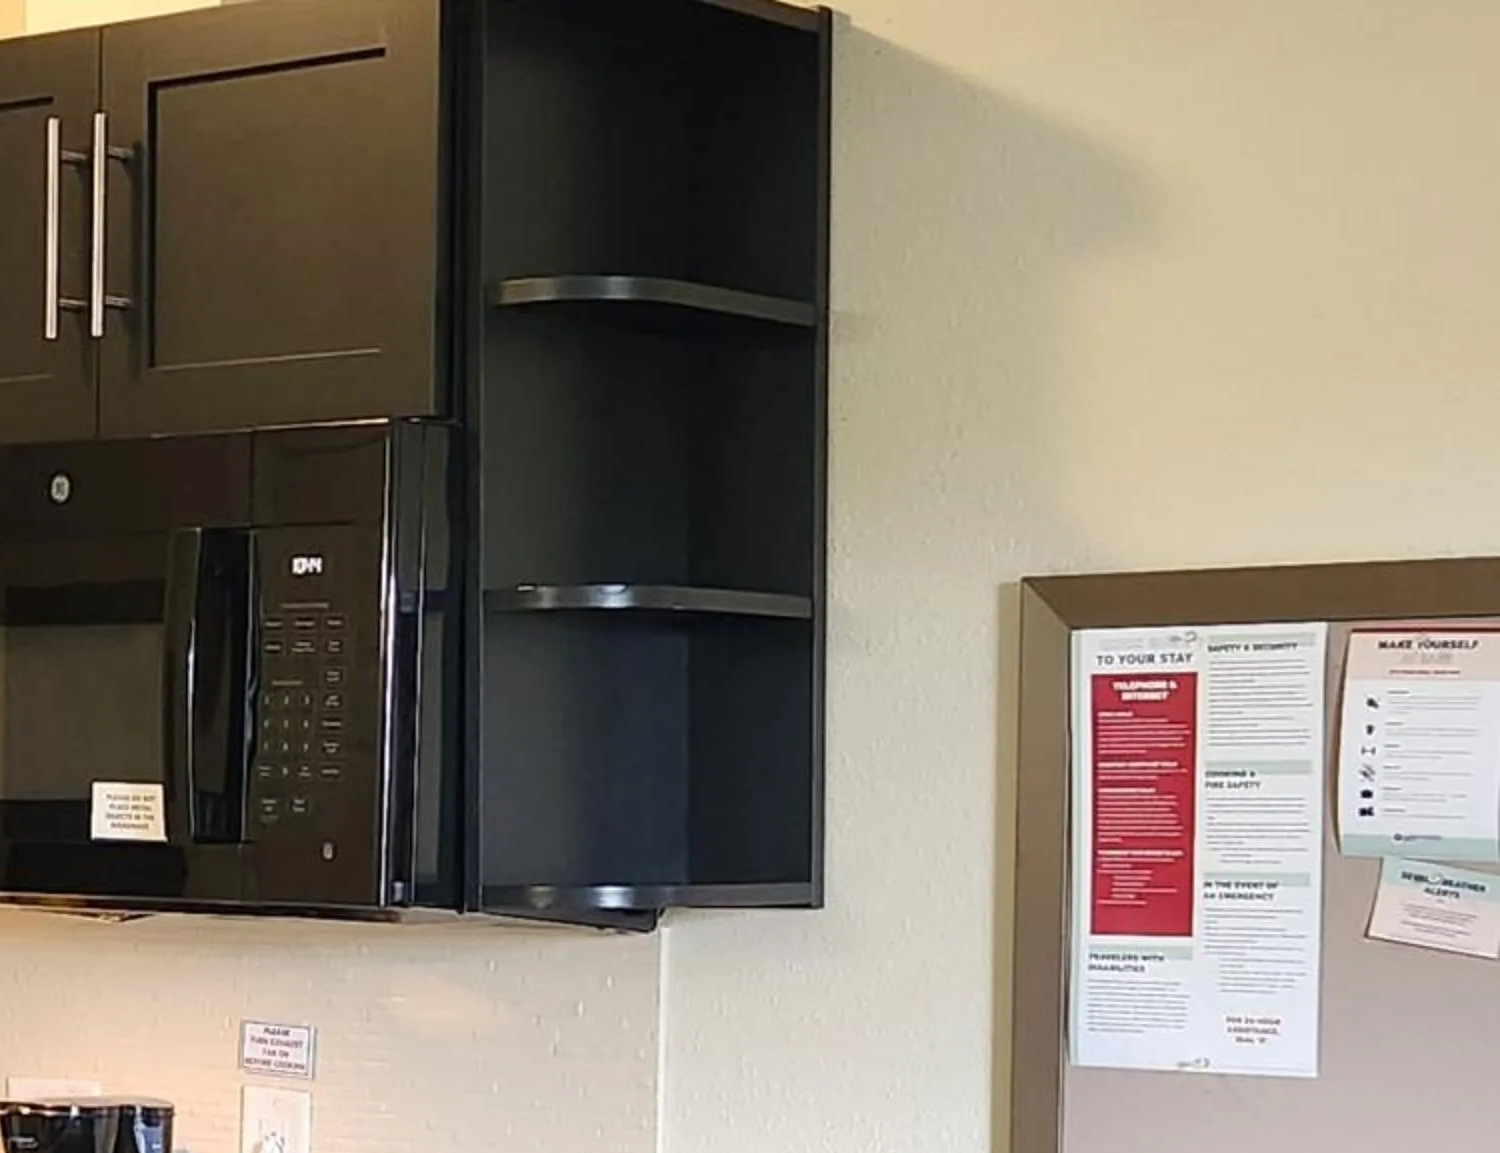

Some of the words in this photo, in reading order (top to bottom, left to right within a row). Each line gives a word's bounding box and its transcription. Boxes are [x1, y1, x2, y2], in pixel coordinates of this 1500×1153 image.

[1378, 639, 1412, 649] MAKE
[1417, 638, 1479, 649] YOURSELF
[1096, 654, 1114, 666] TO
[1118, 653, 1155, 665] YOUR
[1160, 652, 1193, 664] STAY
